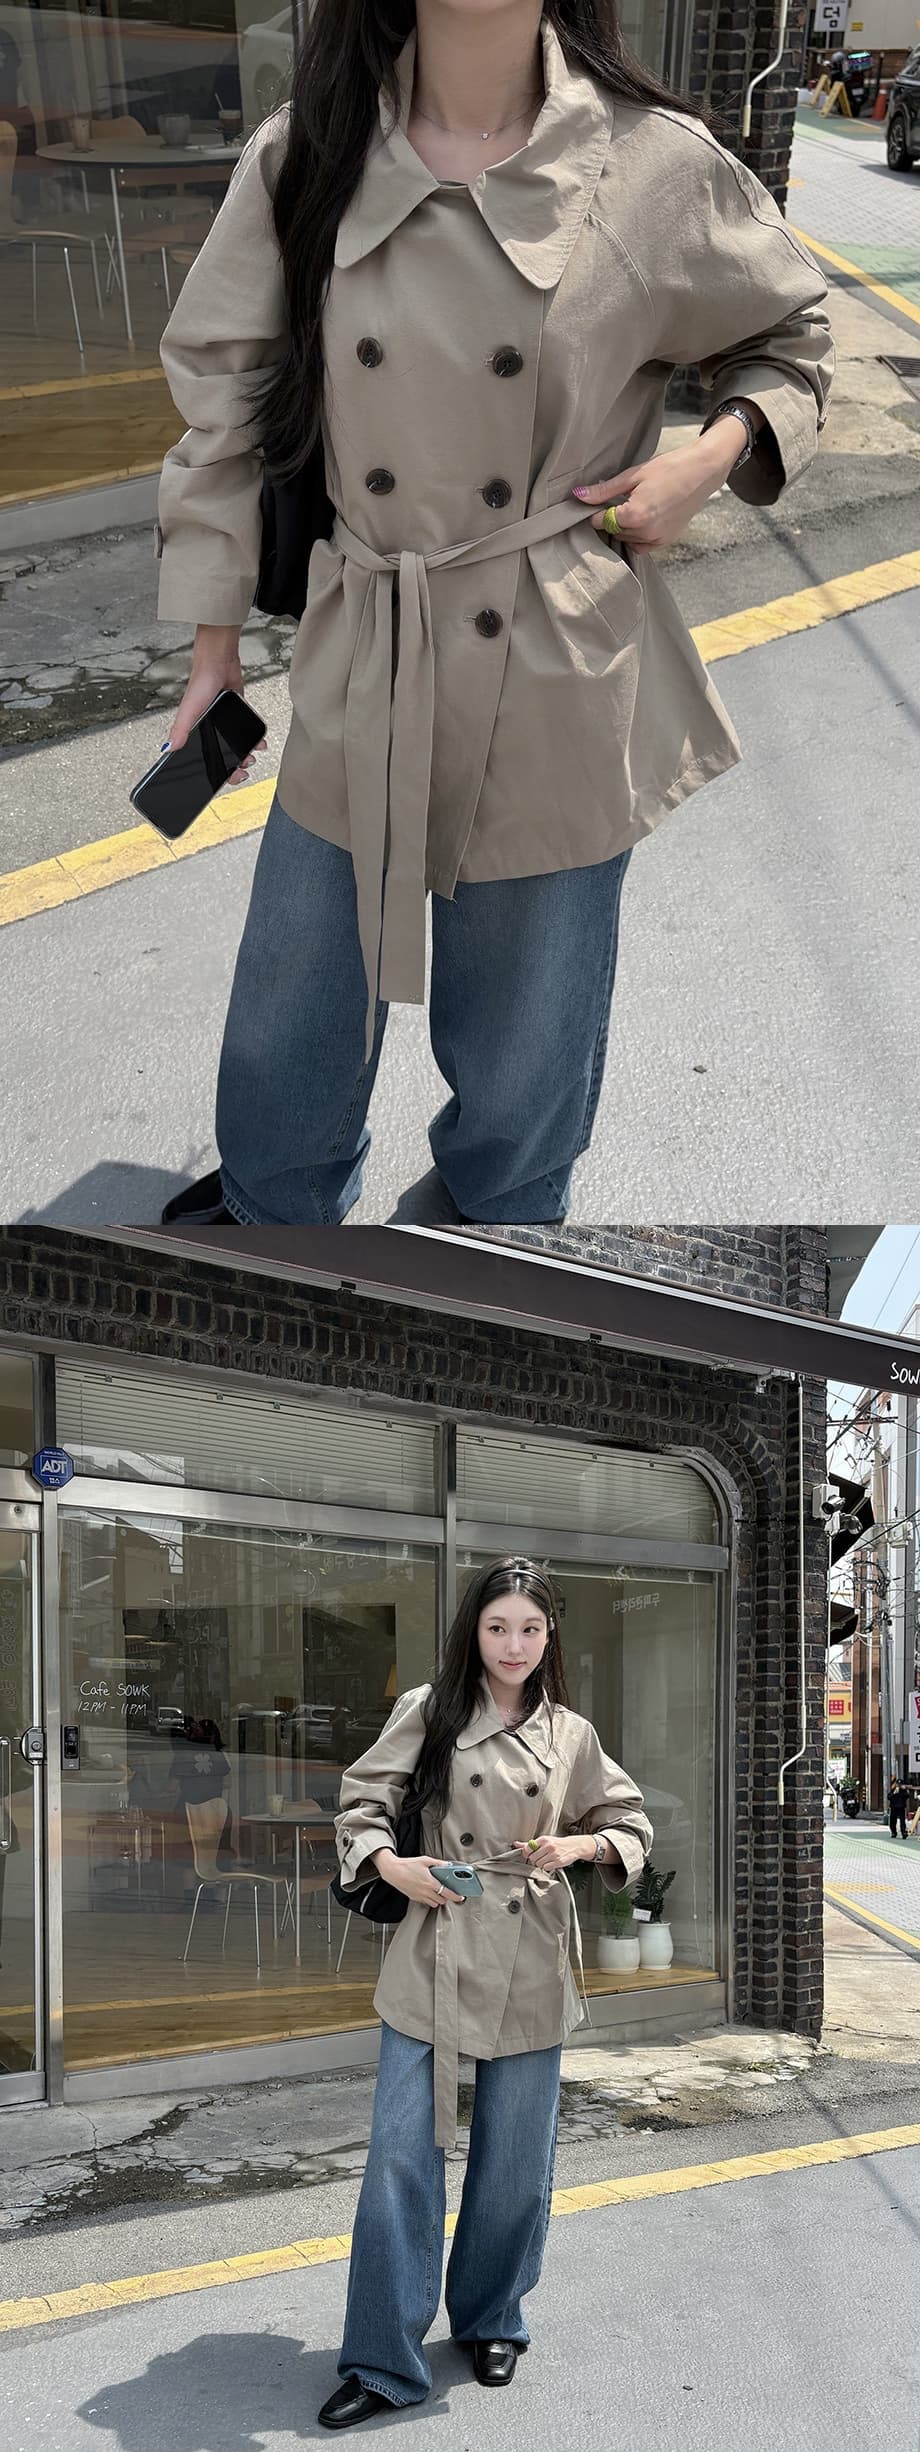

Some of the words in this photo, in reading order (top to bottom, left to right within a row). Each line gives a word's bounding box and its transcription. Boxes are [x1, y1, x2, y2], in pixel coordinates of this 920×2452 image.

[890, 1362, 920, 1385] SOW
[41, 1459, 67, 1474] ADT
[80, 1680, 110, 1696] Cafe
[116, 1683, 151, 1698] SOWK
[78, 1701, 107, 1713] 12PM
[121, 1703, 147, 1716] 11PM
